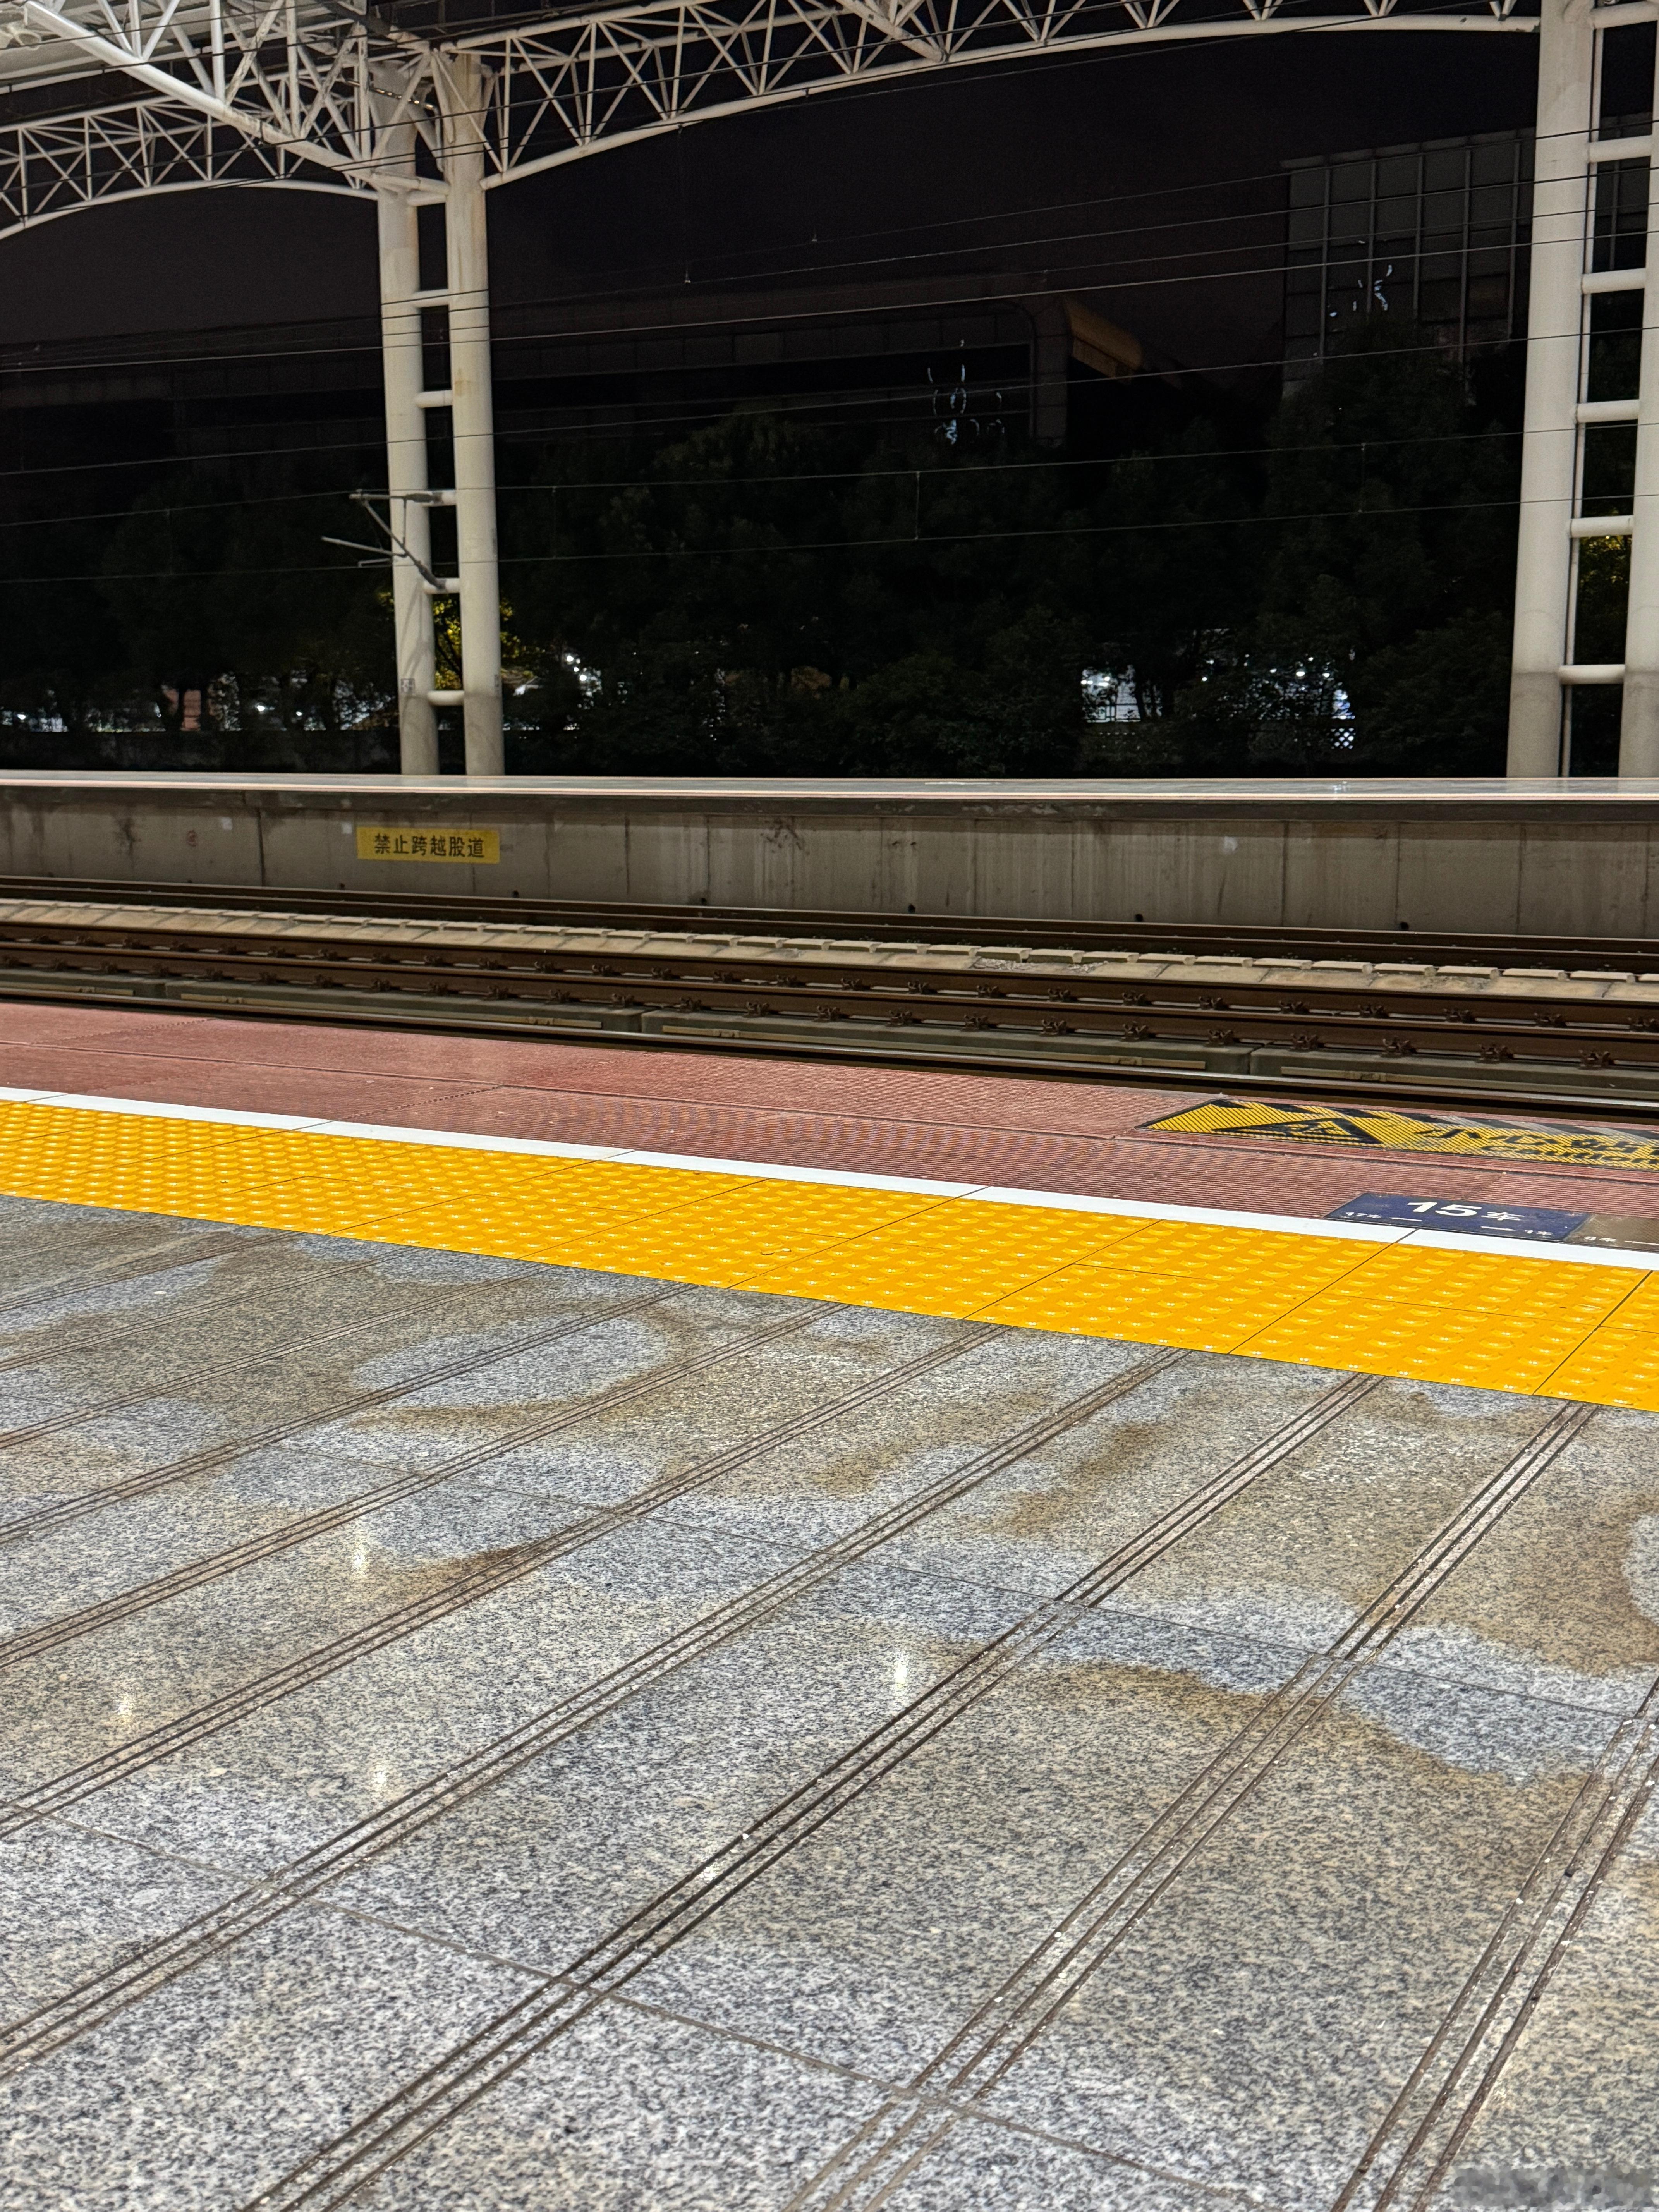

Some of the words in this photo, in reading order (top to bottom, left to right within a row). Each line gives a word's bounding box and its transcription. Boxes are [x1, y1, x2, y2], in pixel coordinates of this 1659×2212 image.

[374, 834, 484, 858] 禁止跨越股道
[1407, 1202, 1525, 1221] 15车
